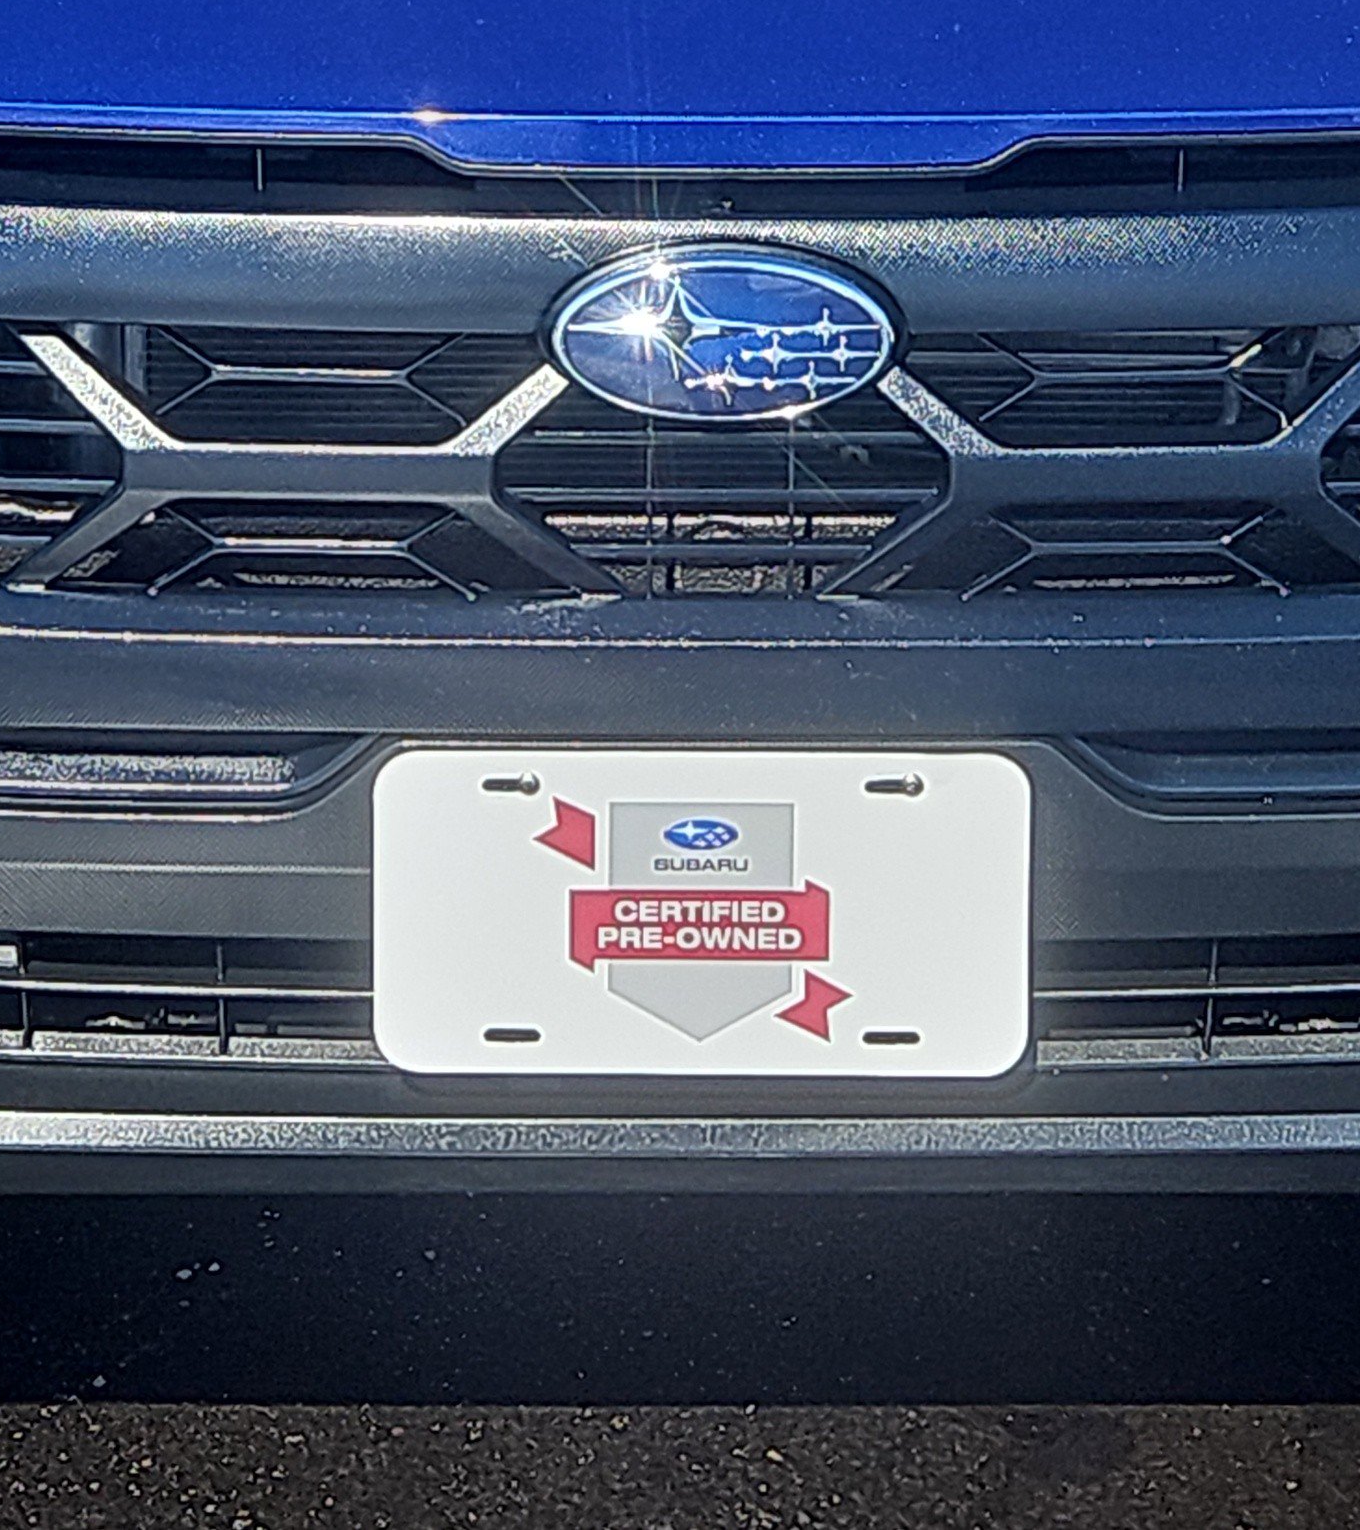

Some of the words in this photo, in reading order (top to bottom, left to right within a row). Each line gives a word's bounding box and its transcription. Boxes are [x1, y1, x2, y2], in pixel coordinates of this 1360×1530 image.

[653, 858, 749, 872] SUBARU
[614, 900, 786, 923] CERTIFIED
[597, 926, 803, 950] PRE-OWNED
